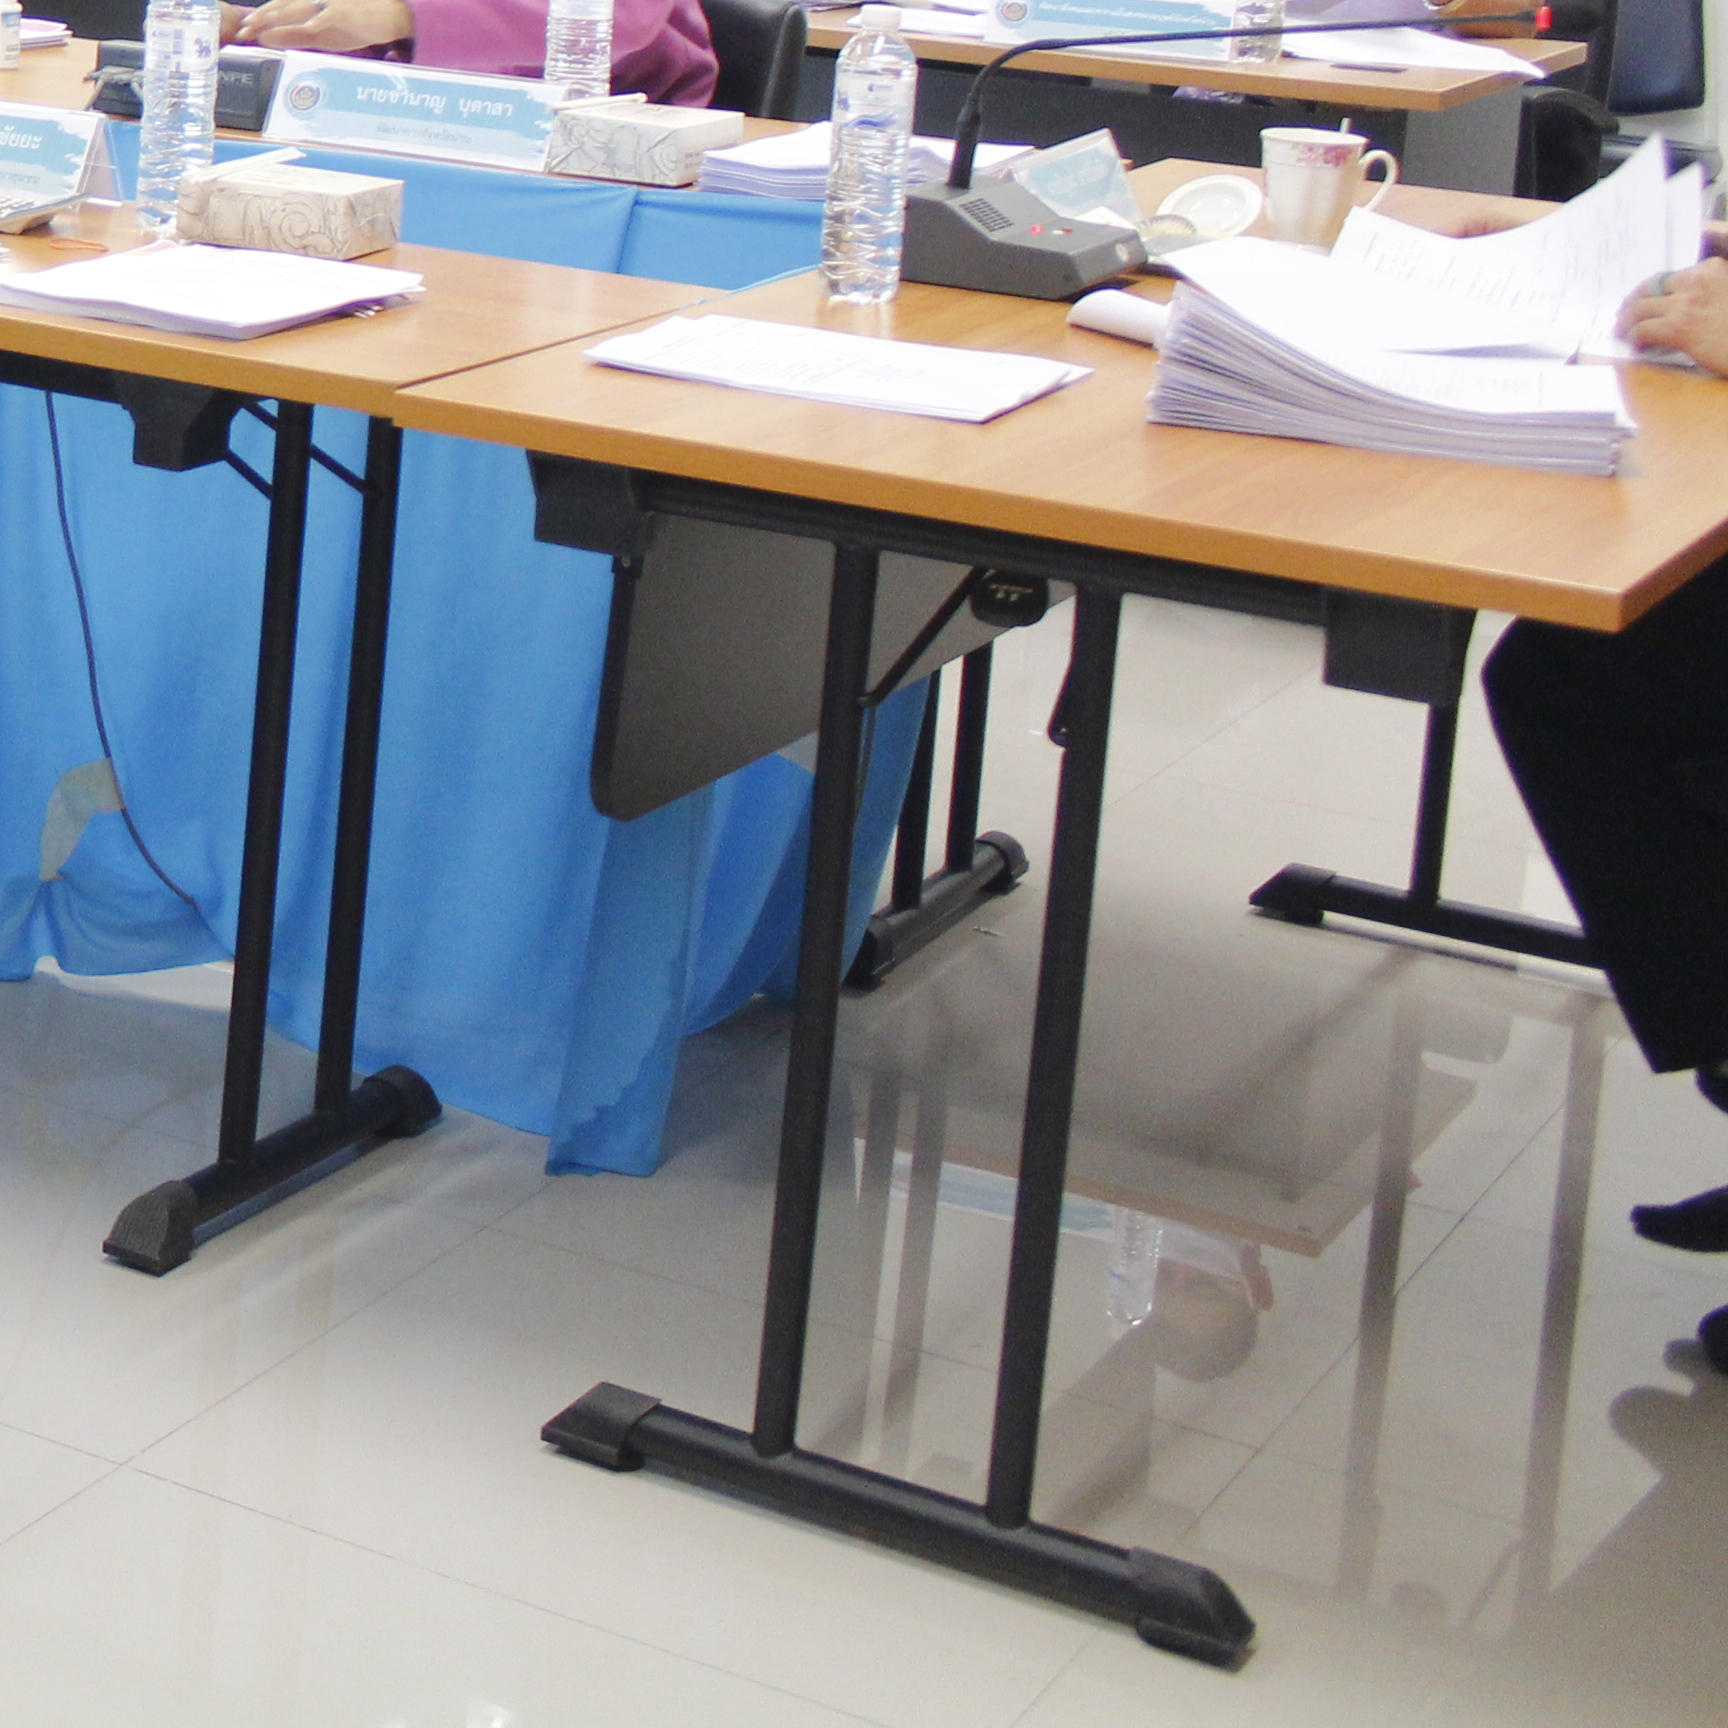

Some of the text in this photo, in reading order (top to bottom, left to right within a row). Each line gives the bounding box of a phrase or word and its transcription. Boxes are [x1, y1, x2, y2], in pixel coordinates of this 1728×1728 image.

[356, 86, 513, 121] นายชำนาญ บุดาสา
